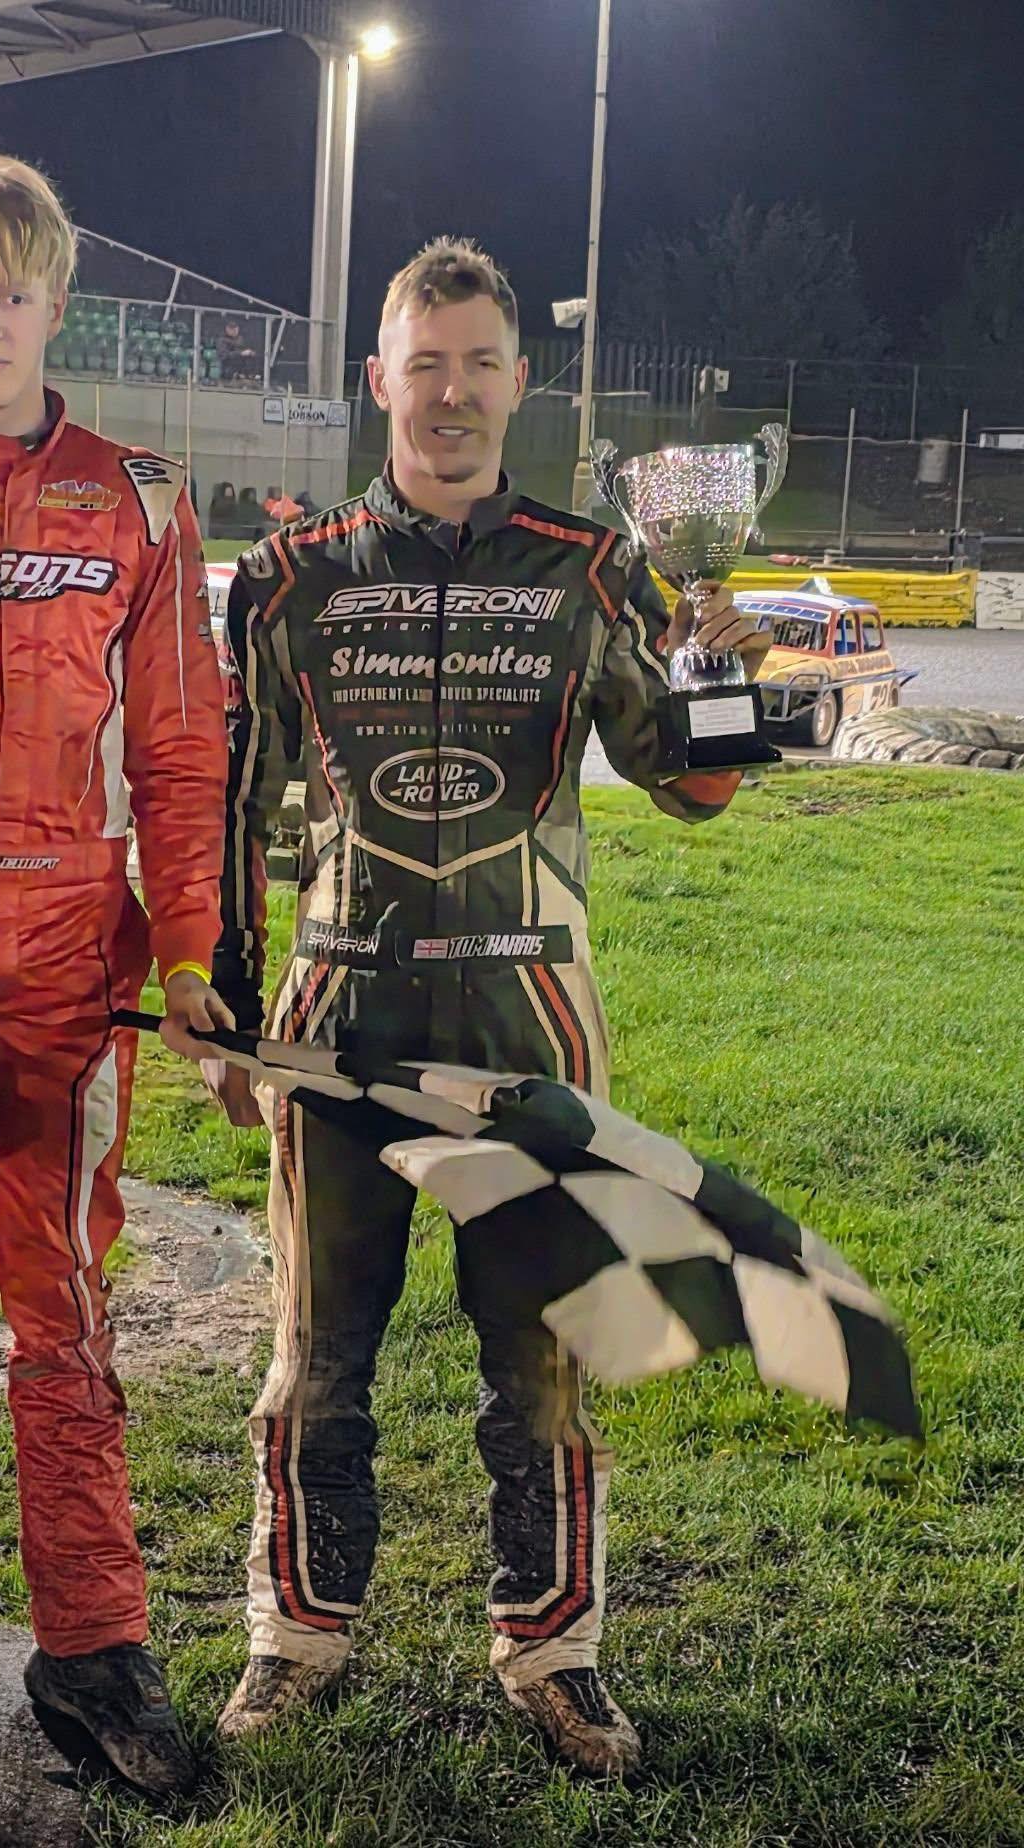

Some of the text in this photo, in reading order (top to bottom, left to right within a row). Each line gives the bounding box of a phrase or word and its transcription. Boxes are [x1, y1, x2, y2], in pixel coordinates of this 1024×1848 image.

[327, 588, 543, 615] SPIVERON
[332, 687, 402, 703] INDEPENDENT
[405, 687, 433, 702] LA
[477, 687, 541, 703] SPECIALISTS
[397, 763, 464, 783] LAND
[402, 782, 480, 803] ROVER
